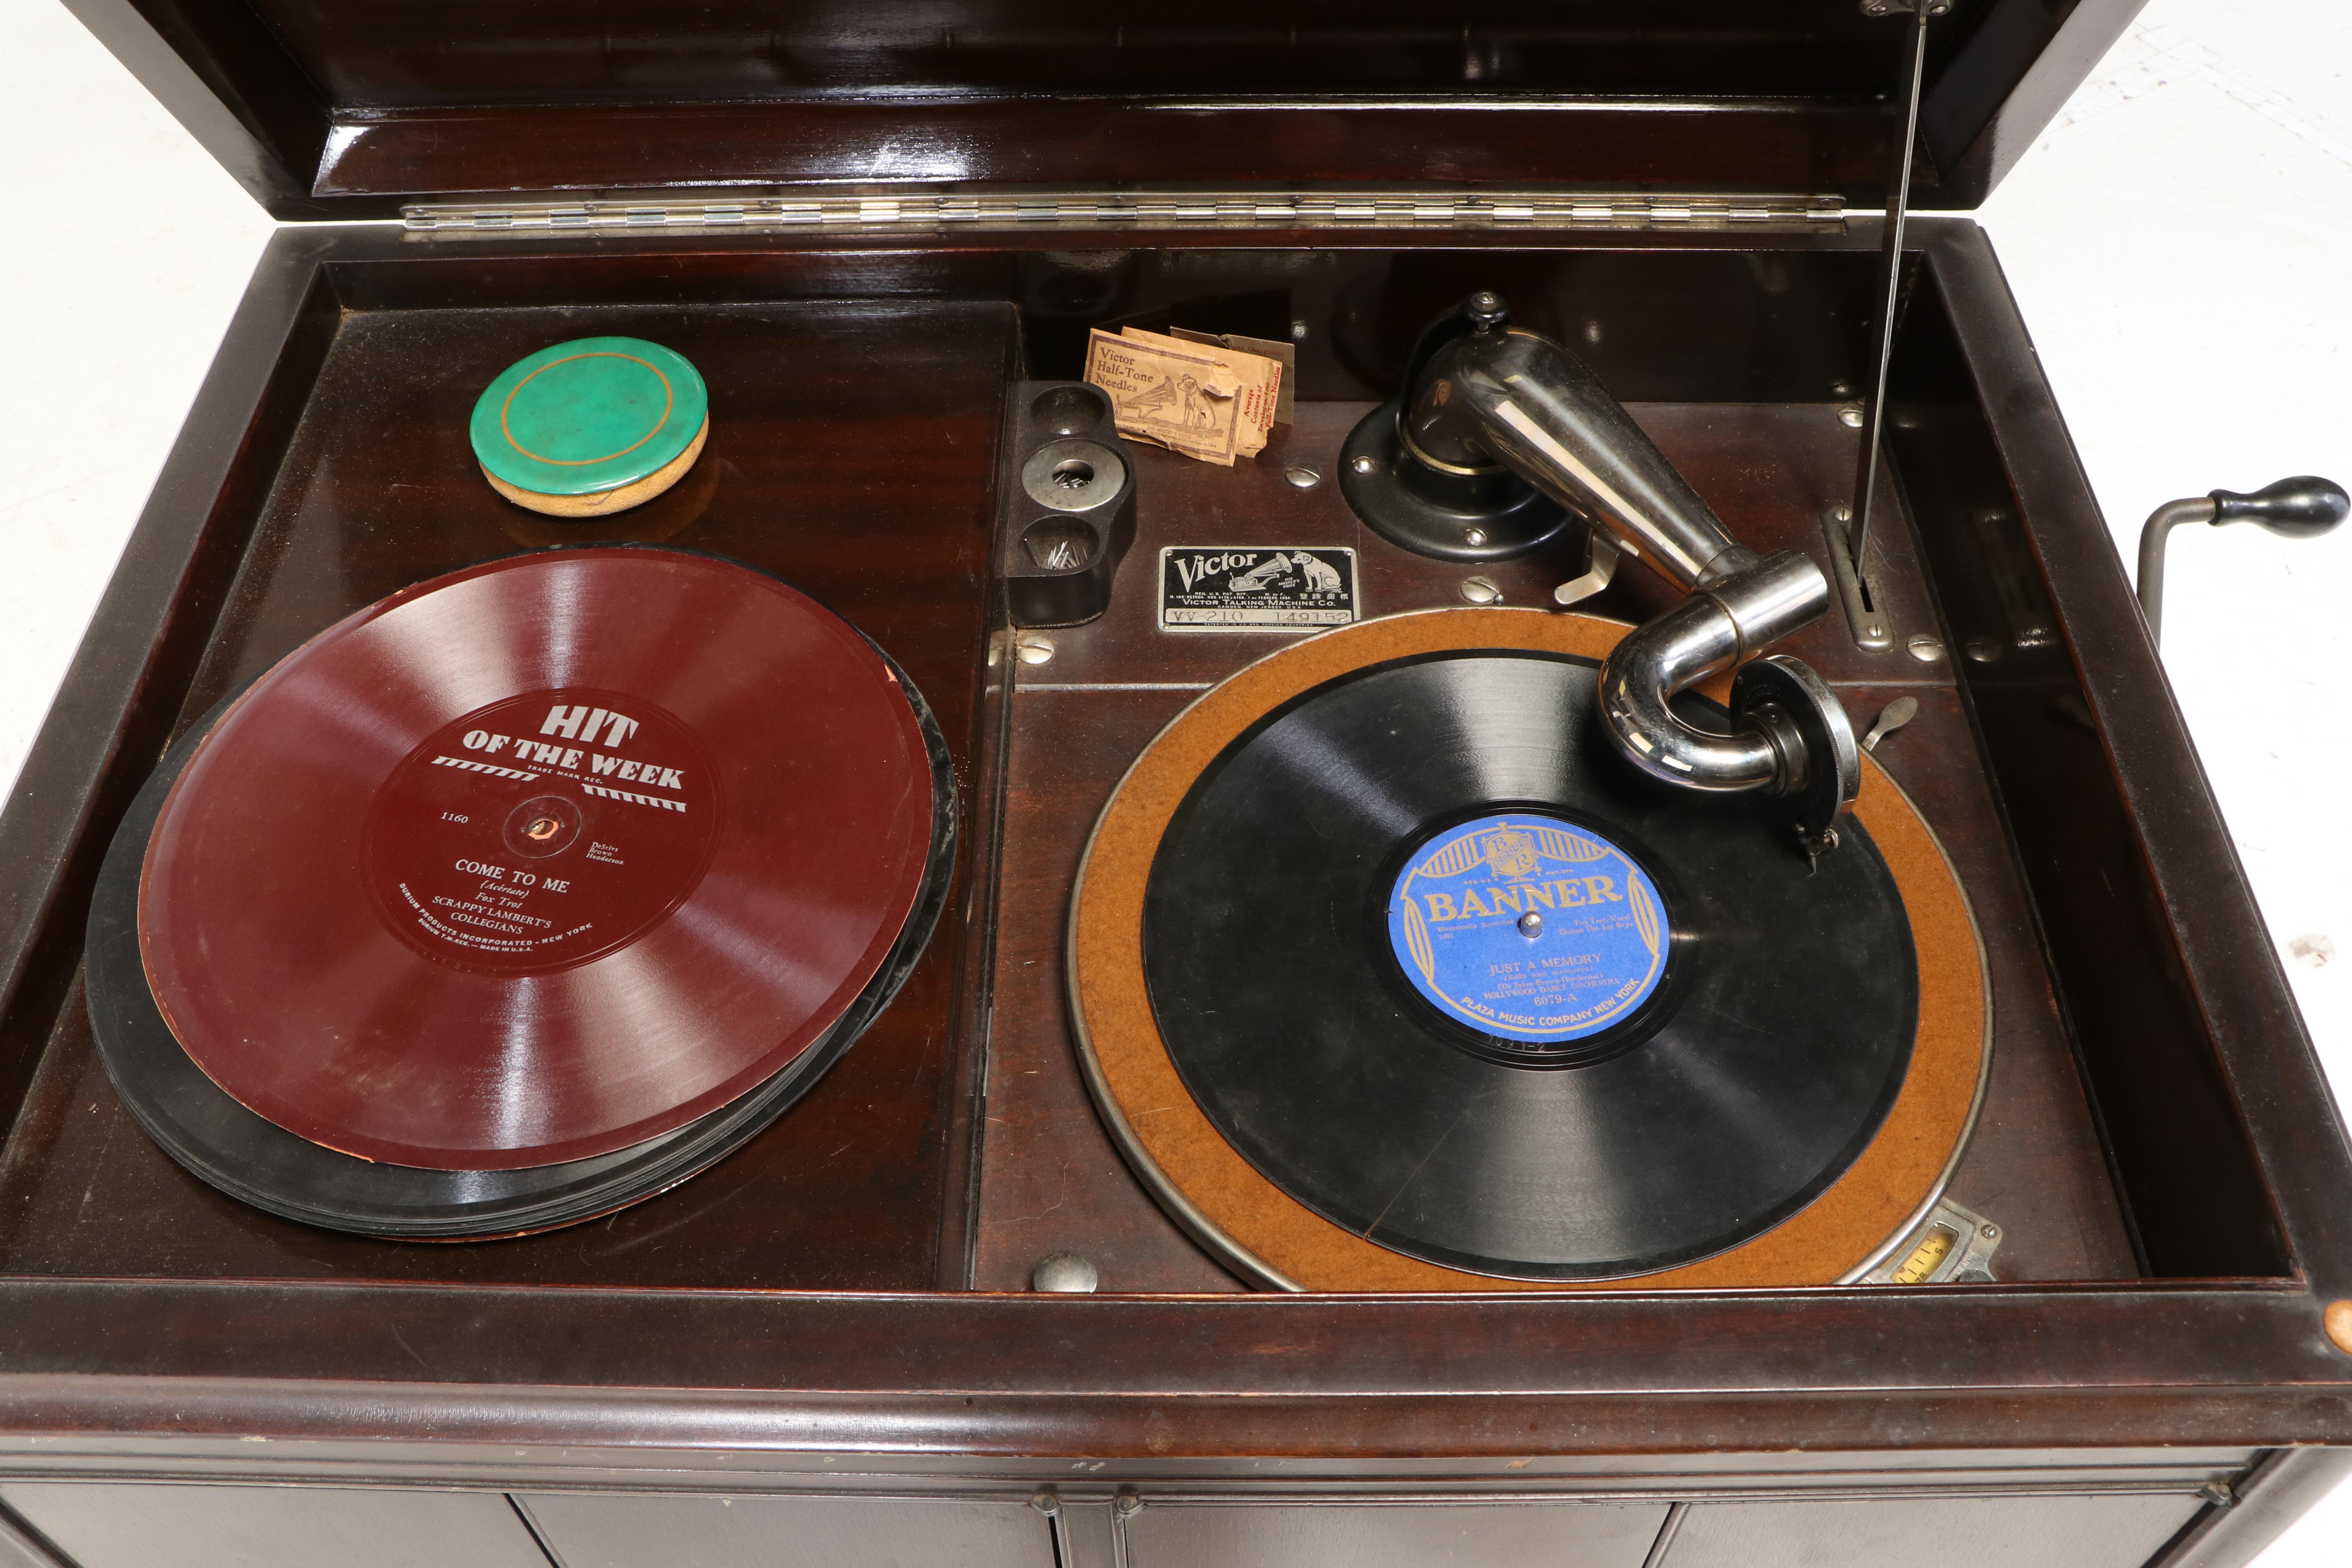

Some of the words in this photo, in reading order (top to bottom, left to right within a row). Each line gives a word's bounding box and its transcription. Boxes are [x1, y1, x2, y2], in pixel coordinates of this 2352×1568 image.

[1100, 347, 1134, 365] Victor
[1095, 373, 1138, 392] Needles
[1097, 360, 1154, 383] Half-Tone
[1270, 367, 1281, 393] Needles
[1244, 389, 1254, 417] Average
[1251, 395, 1261, 424] Contents
[1265, 395, 1276, 428] Full-Tone
[1174, 552, 1257, 592] Victor
[1172, 611, 1243, 622] VV-210
[1273, 612, 1348, 622] 149152
[539, 705, 639, 748] HIT
[463, 730, 511, 753] OF
[514, 739, 584, 769] THE
[592, 753, 685, 789] WEEK
[527, 764, 553, 774] TRADE
[556, 771, 580, 780] MARK
[441, 811, 469, 824] 1160
[588, 847, 612, 857] Brown
[1492, 837, 1507, 852] B
[586, 853, 624, 865] Henderson
[1515, 854, 1530, 870] R
[455, 859, 505, 879] COME
[512, 871, 536, 886] TO
[542, 878, 570, 893] ME
[474, 892, 495, 903] Fox
[498, 897, 523, 909] Trot
[1423, 875, 1624, 922] BANNER
[399, 882, 420, 909] DURIUM
[419, 908, 458, 936] PRODUCTS
[459, 933, 533, 946] INCORPORATED
[542, 934, 563, 944] NEW
[566, 922, 593, 936] YORK
[432, 896, 487, 914] SCRAPPY
[486, 907, 552, 929] LAMBERT'S
[450, 912, 524, 935] COLLEGIANS
[418, 918, 440, 936] DURIUM
[1437, 923, 1477, 932] Electrically
[1481, 919, 1514, 927] Recorded
[1490, 962, 1521, 977] JUST
[1527, 961, 1537, 971] A
[1541, 953, 1601, 968] MEMORY
[1484, 988, 1536, 1000] HOLLYWOOD
[1539, 984, 1567, 993] DANCE
[1571, 978, 1621, 989] ORCHESTRA
[1534, 993, 1578, 1006] 6079-A
[1461, 996, 1495, 1018] PLAZA
[1498, 1011, 1535, 1026] MUSIC
[1539, 1008, 1593, 1026] COMPANY
[1593, 997, 1617, 1014] NEW
[1615, 978, 1641, 1000] YORK
